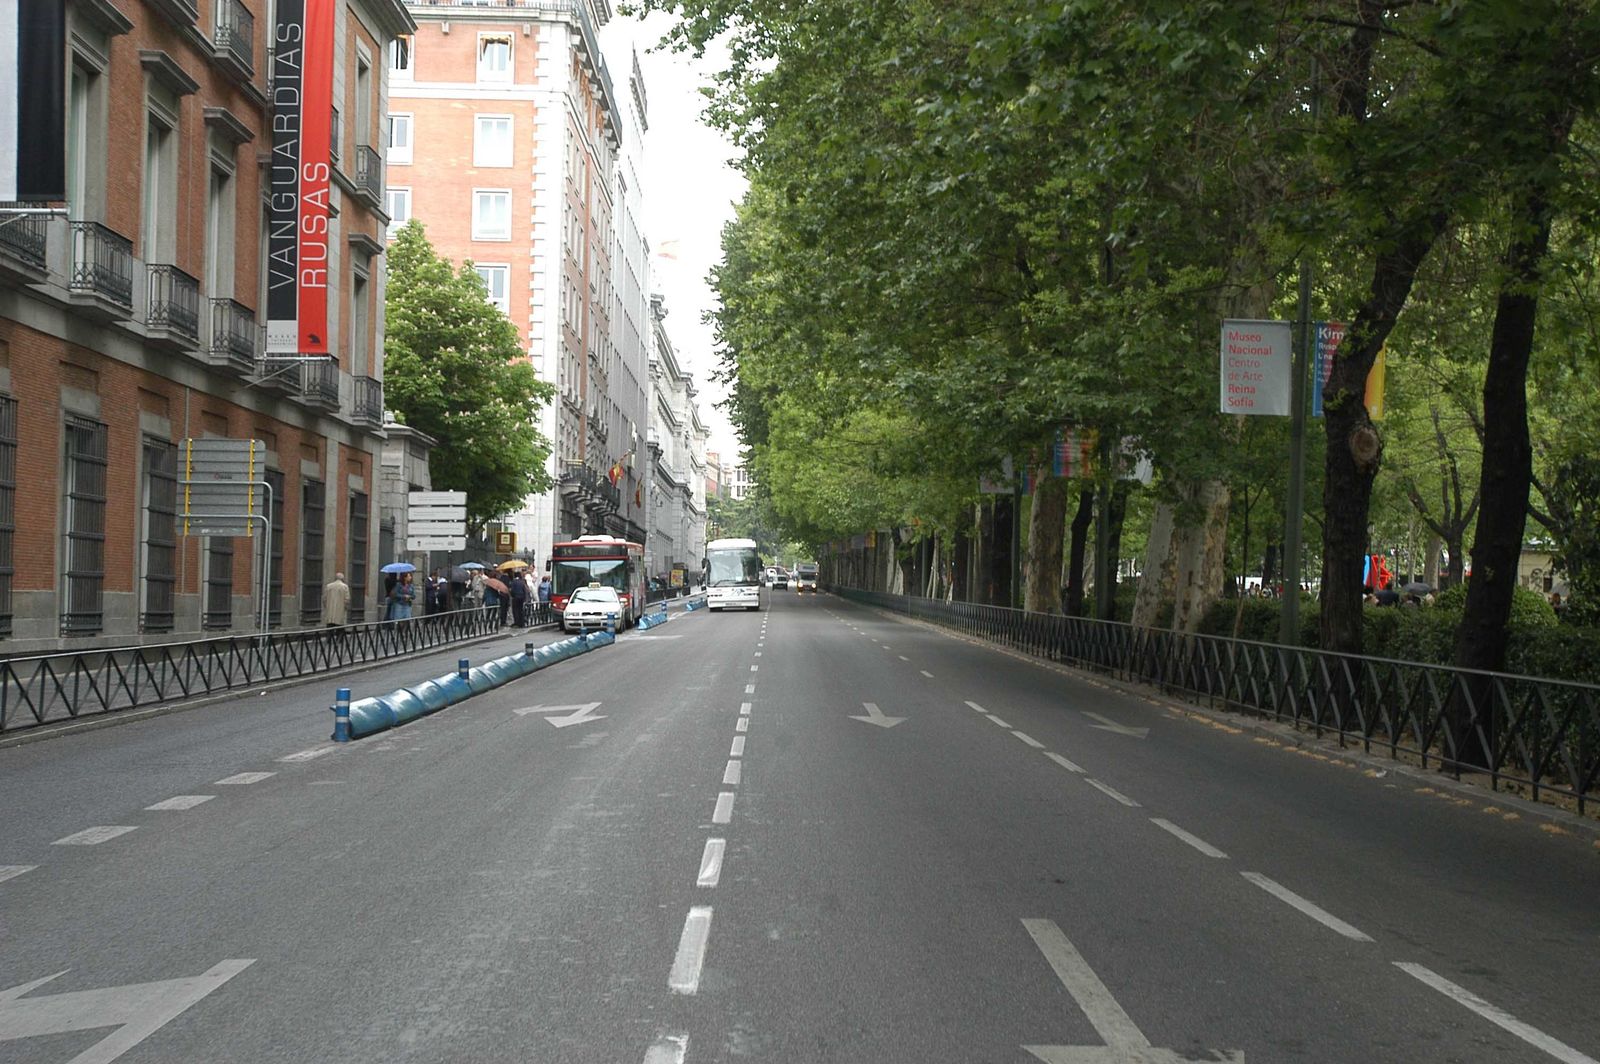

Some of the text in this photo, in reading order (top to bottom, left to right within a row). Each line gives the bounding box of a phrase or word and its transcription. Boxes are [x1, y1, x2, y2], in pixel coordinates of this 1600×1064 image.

[269, 23, 302, 289] VANGUARDIAS
[301, 162, 329, 288] RUSAS
[1228, 331, 1262, 342] Museo
[1318, 327, 1345, 340] Kim
[1228, 344, 1273, 356] Nacional
[1228, 357, 1262, 368] Centro
[1228, 370, 1264, 382] de Arte
[1228, 383, 1256, 395] Reina
